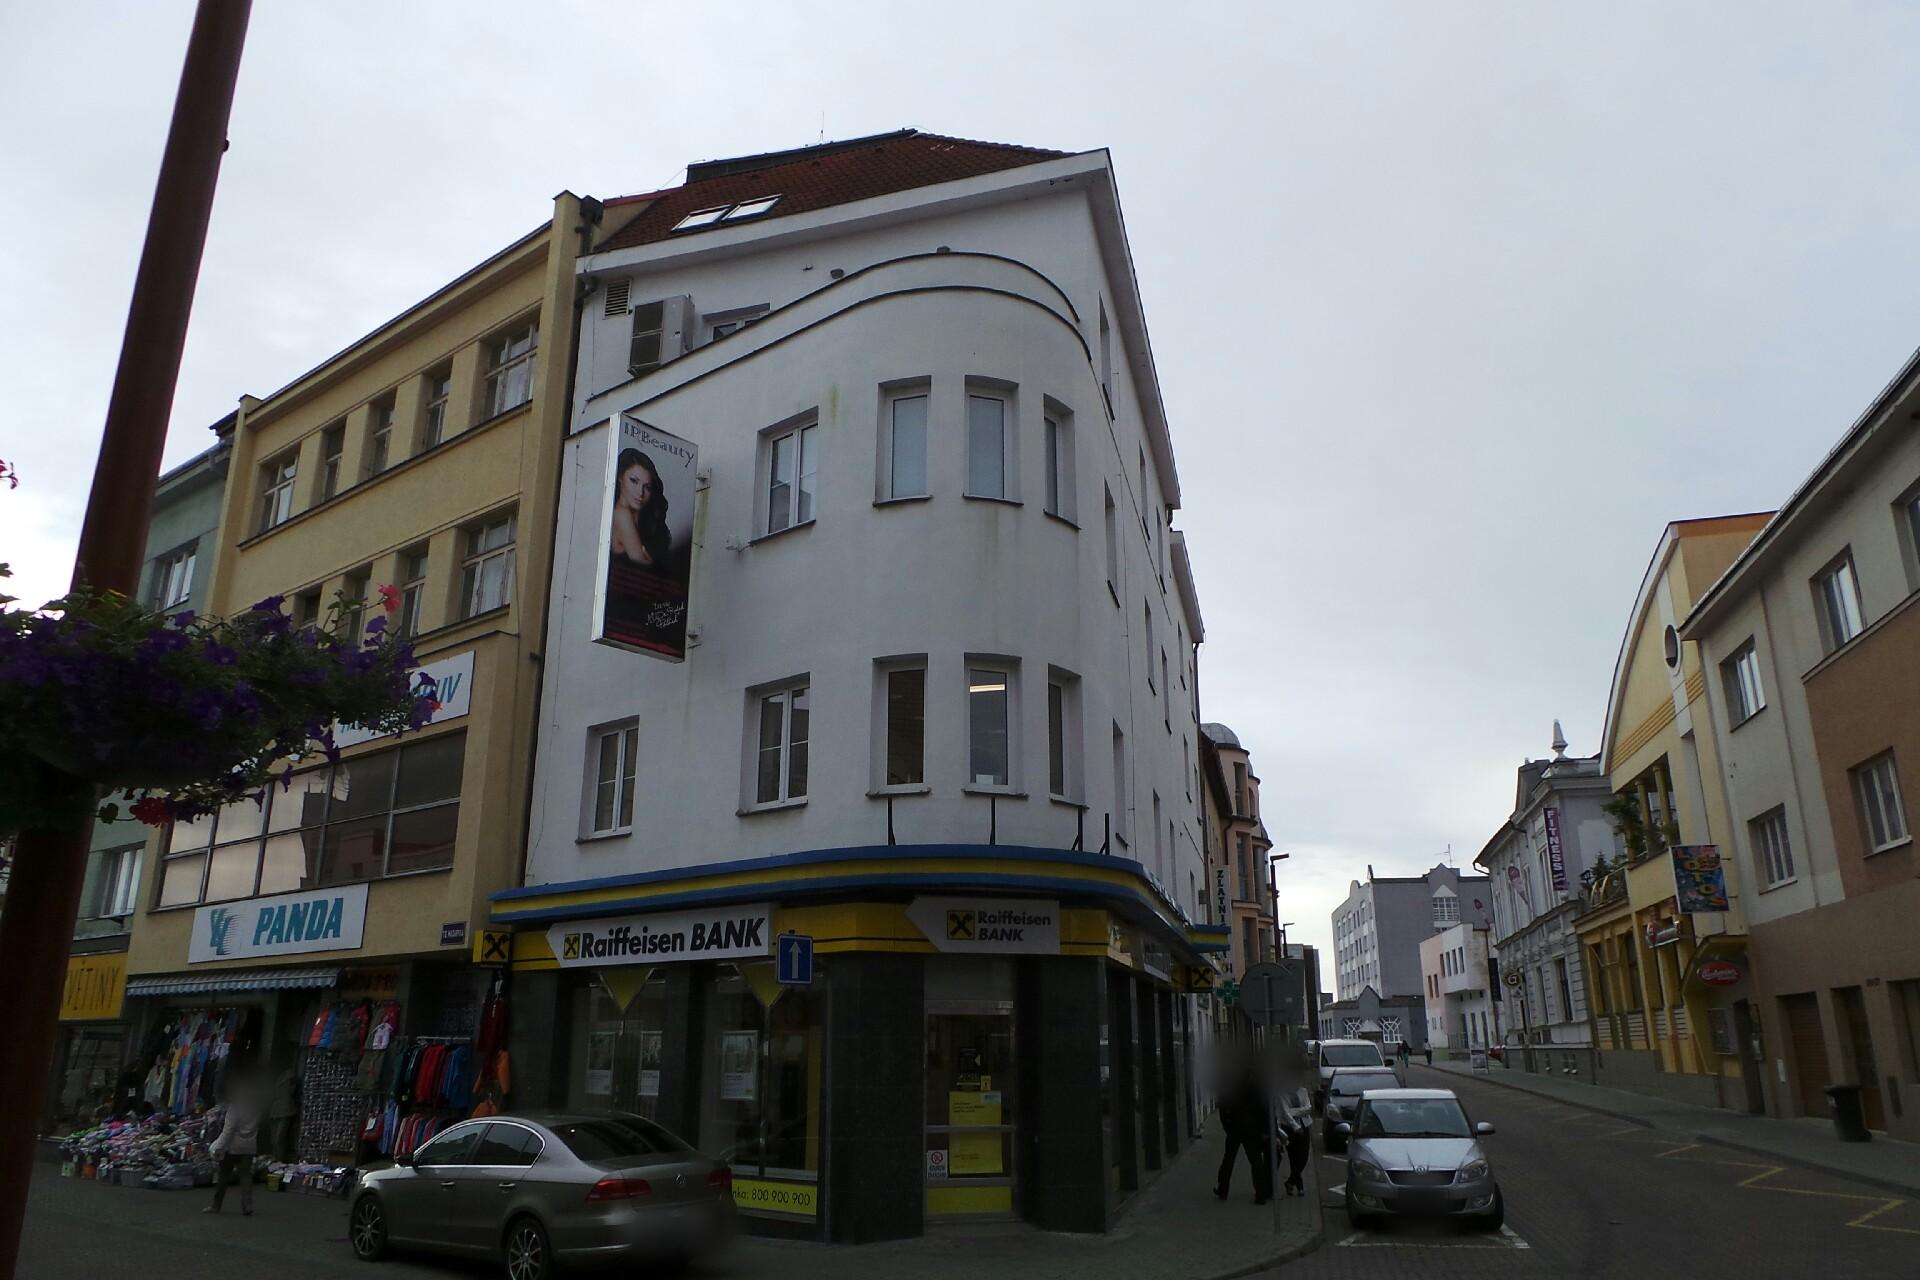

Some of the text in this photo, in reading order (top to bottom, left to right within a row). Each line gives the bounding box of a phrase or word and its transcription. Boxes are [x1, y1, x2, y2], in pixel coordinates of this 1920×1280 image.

[1546, 809, 1563, 871] FITNESS
[252, 897, 344, 946] PANDA
[977, 909, 1052, 926] Raiffeisen
[580, 917, 766, 959] Raiffeisen BANK
[978, 927, 1025, 942] BANK
[732, 1186, 811, 1207] nka: 800 900 900
